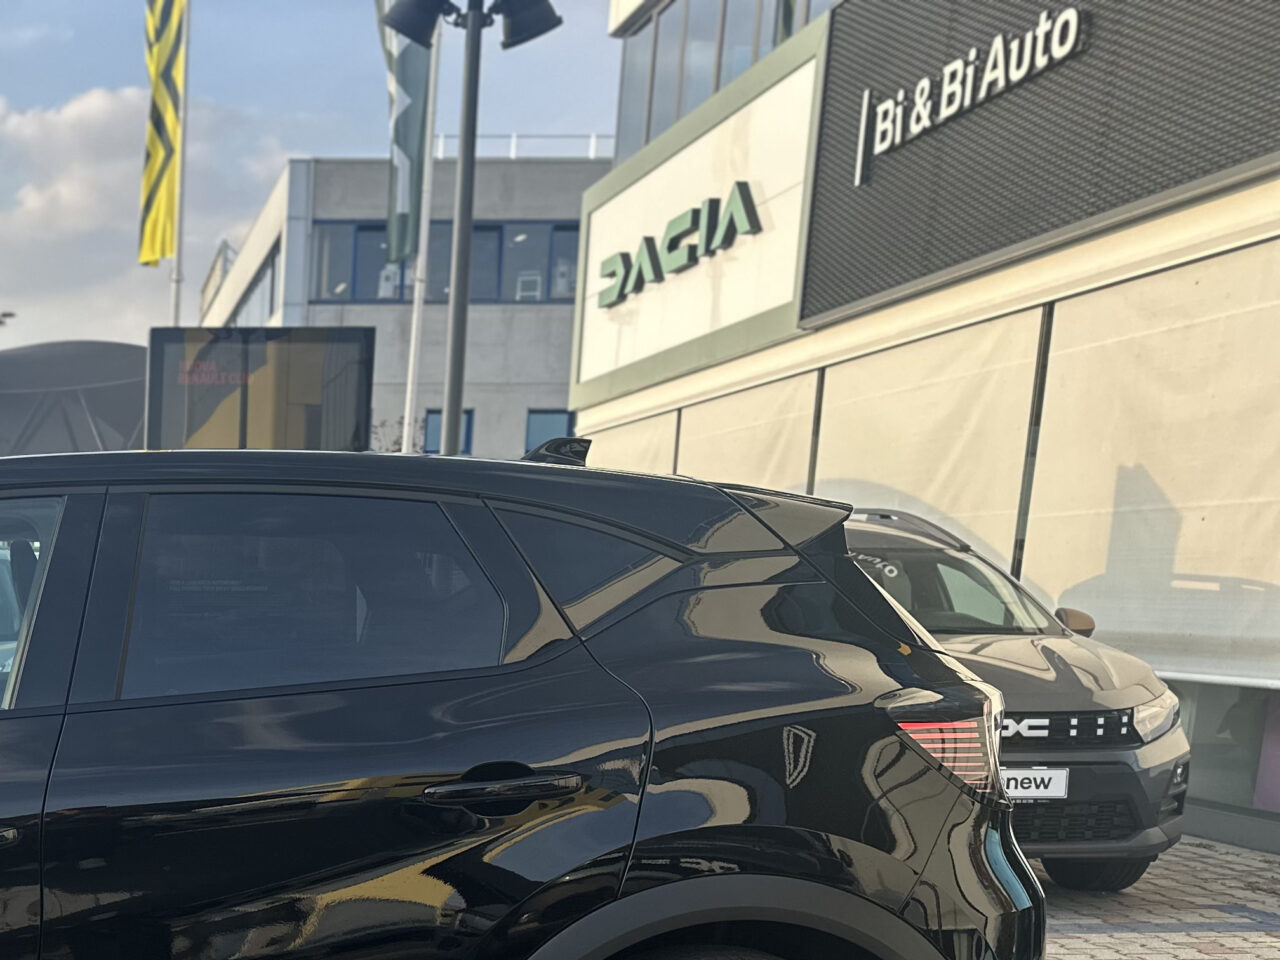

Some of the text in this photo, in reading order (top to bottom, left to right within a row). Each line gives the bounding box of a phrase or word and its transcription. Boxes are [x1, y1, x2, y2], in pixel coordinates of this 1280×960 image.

[873, 7, 1079, 156] Bi & Bi Auto
[598, 180, 763, 309] DACIA
[1005, 776, 1053, 790] new
